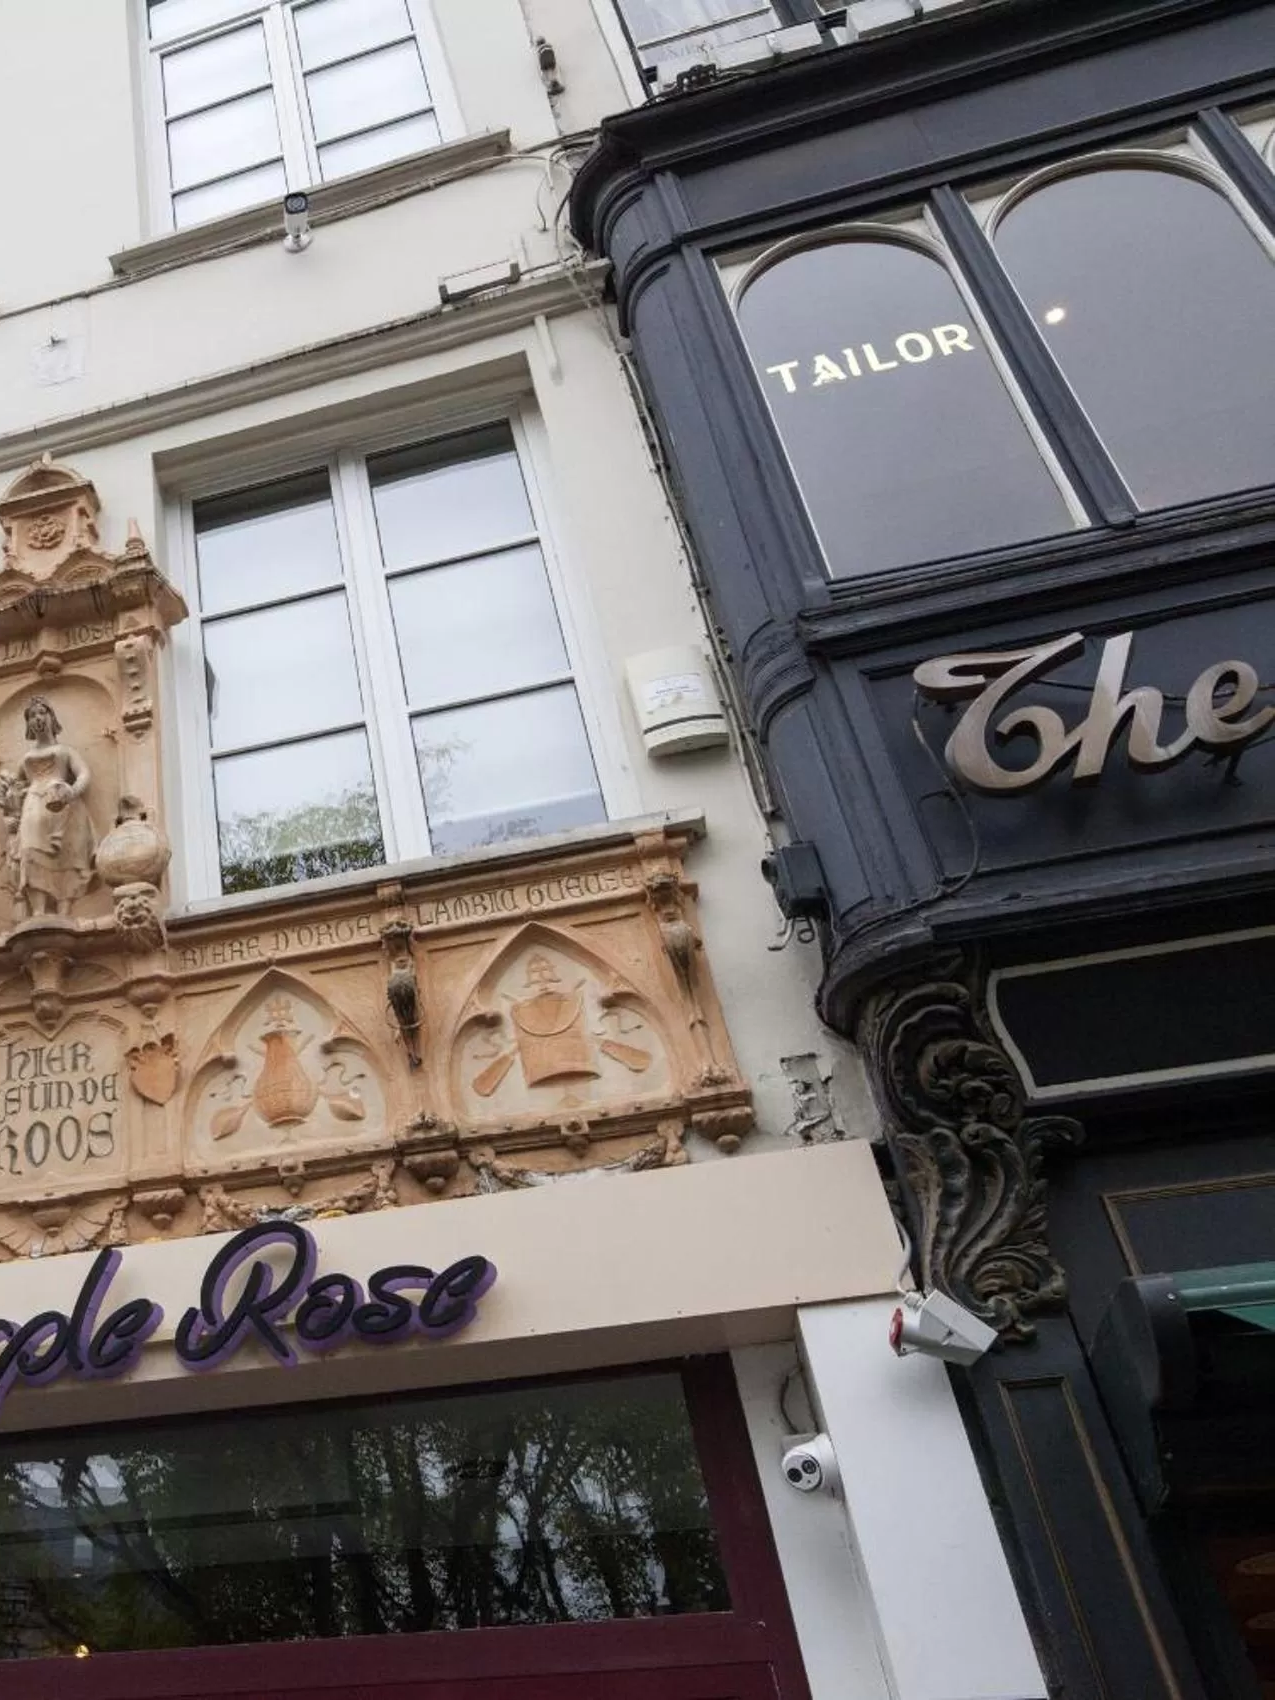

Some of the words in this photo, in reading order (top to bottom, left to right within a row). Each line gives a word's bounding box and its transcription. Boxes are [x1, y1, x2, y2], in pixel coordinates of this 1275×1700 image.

[765, 323, 976, 394] TAILOR
[912, 630, 1275, 790] The
[77, 1071, 120, 1106] DE
[175, 1219, 498, 1371] Rose
